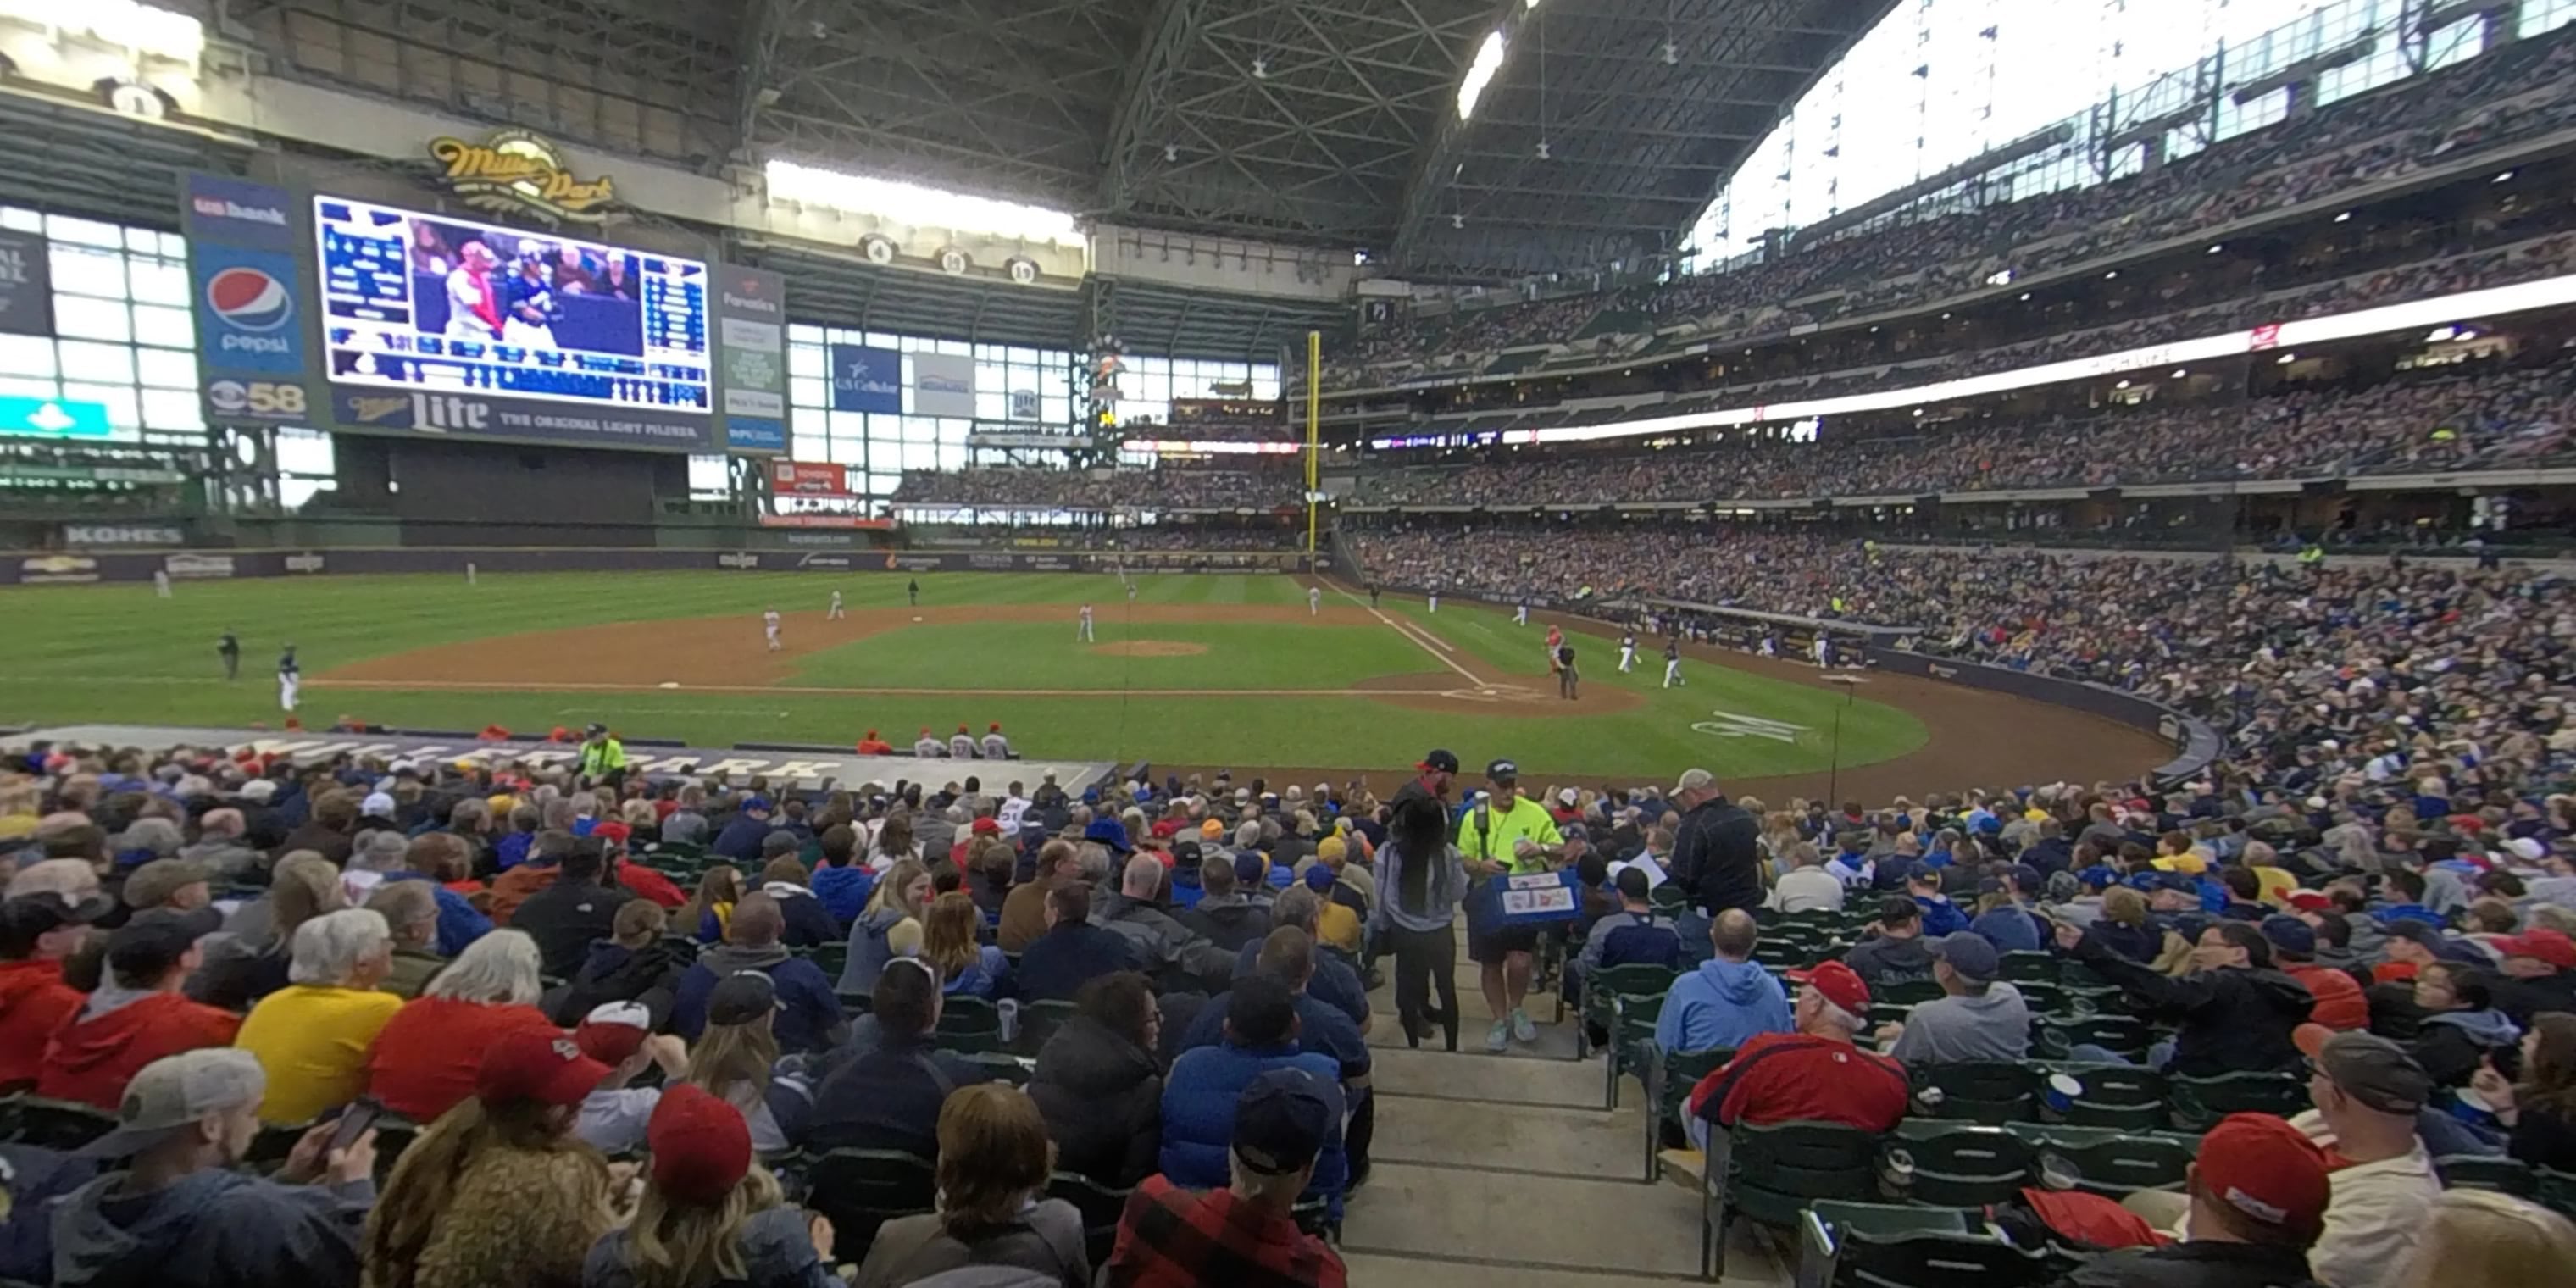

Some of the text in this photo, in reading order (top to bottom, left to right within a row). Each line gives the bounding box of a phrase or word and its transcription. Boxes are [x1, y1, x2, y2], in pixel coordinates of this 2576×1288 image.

[430, 136, 549, 181] Miller
[532, 169, 613, 209] Park
[221, 334, 290, 353] pepsi
[248, 383, 306, 413] 58
[410, 392, 489, 434] Lite
[499, 412, 531, 426] THE
